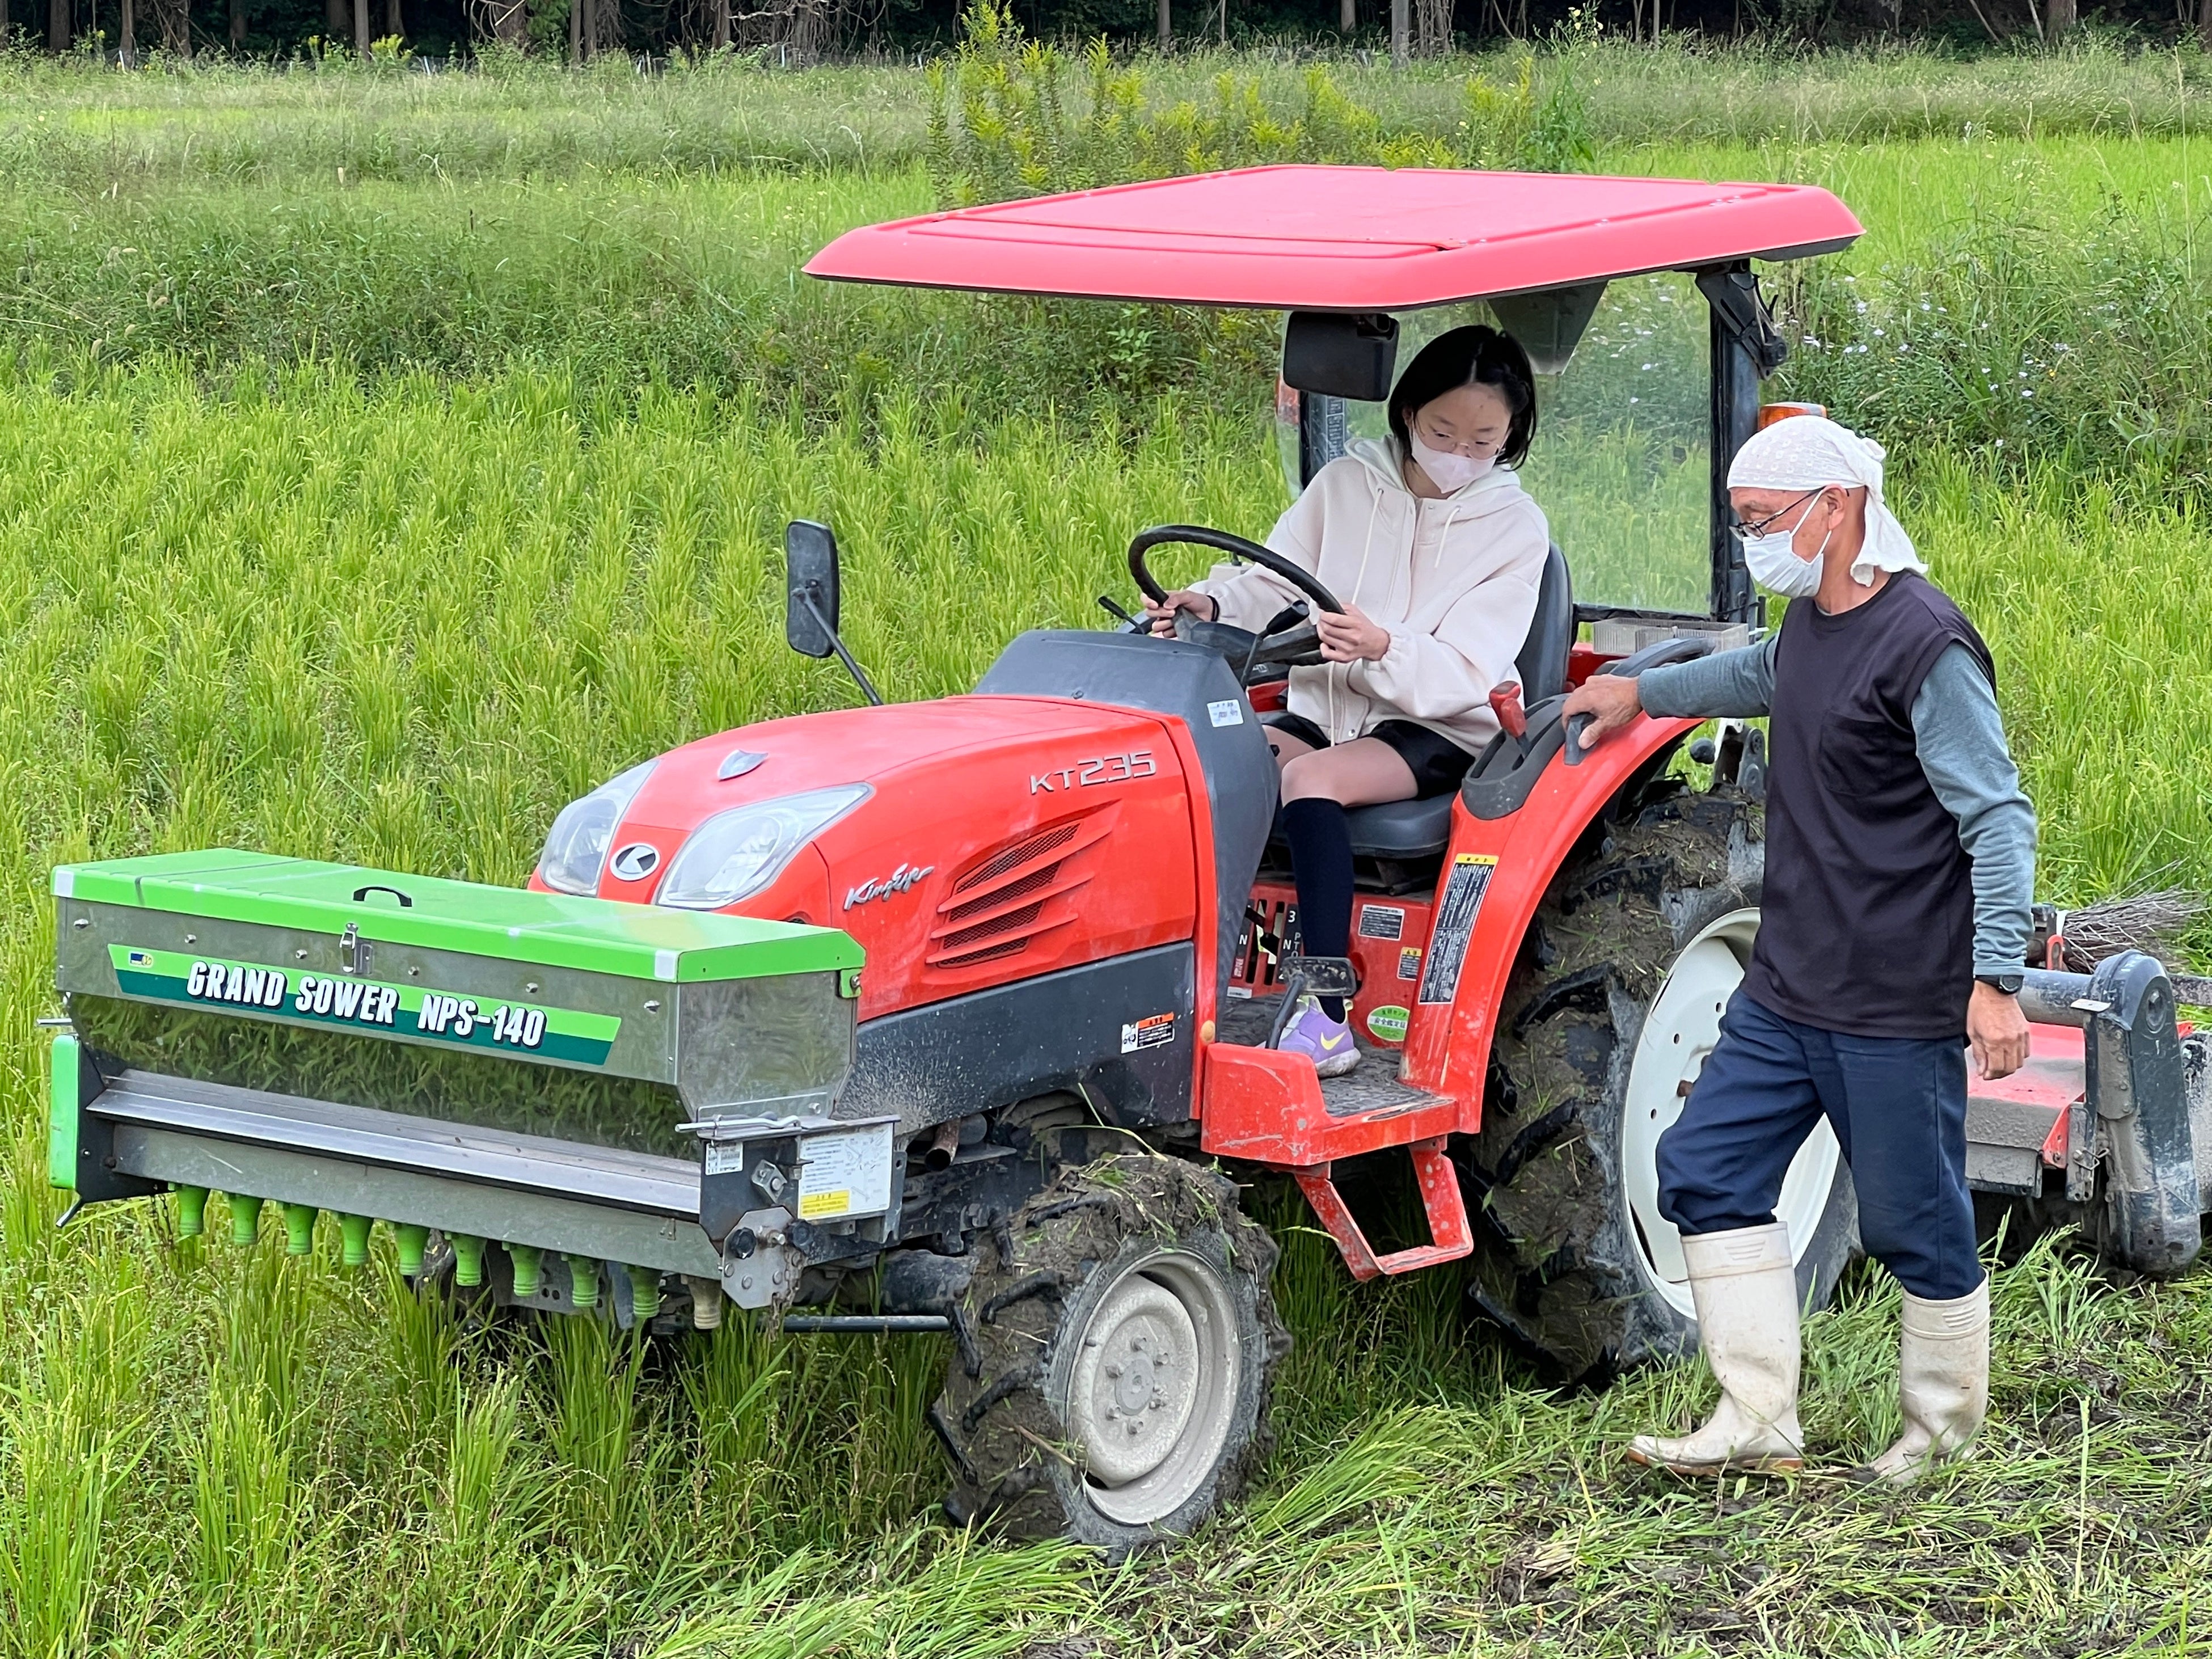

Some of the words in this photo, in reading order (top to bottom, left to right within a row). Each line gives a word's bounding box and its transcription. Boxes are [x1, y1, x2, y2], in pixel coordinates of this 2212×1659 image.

[1029, 750, 1156, 795] KT235
[1288, 910, 1296, 923] 3
[1239, 934, 1248, 945] N
[1283, 939, 1291, 951] N
[187, 961, 288, 1007] GRAND
[295, 976, 400, 1024] SOWER
[417, 994, 547, 1048] NPS-140
